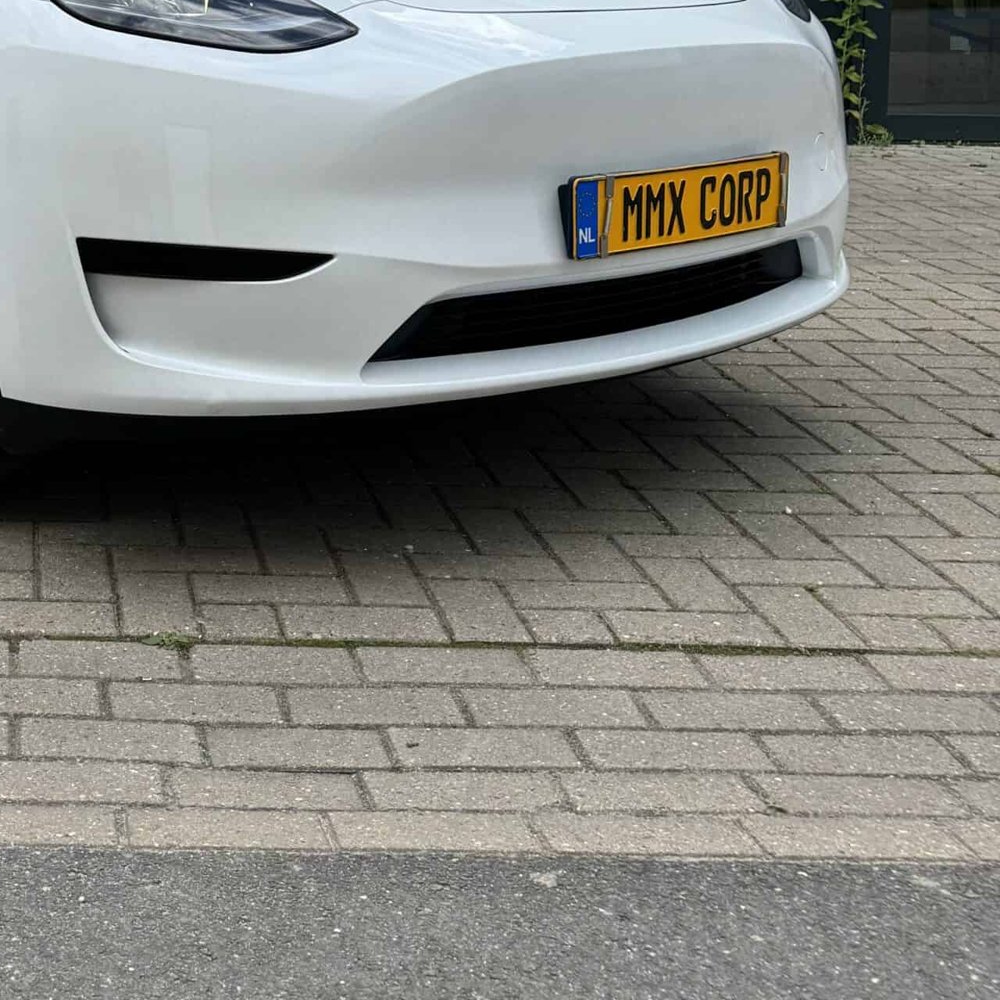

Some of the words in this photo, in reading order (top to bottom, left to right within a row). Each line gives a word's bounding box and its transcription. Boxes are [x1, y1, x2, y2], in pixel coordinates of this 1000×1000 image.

[621, 179, 687, 242] MMX
[699, 167, 772, 230] CORP
[578, 227, 596, 244] NL
